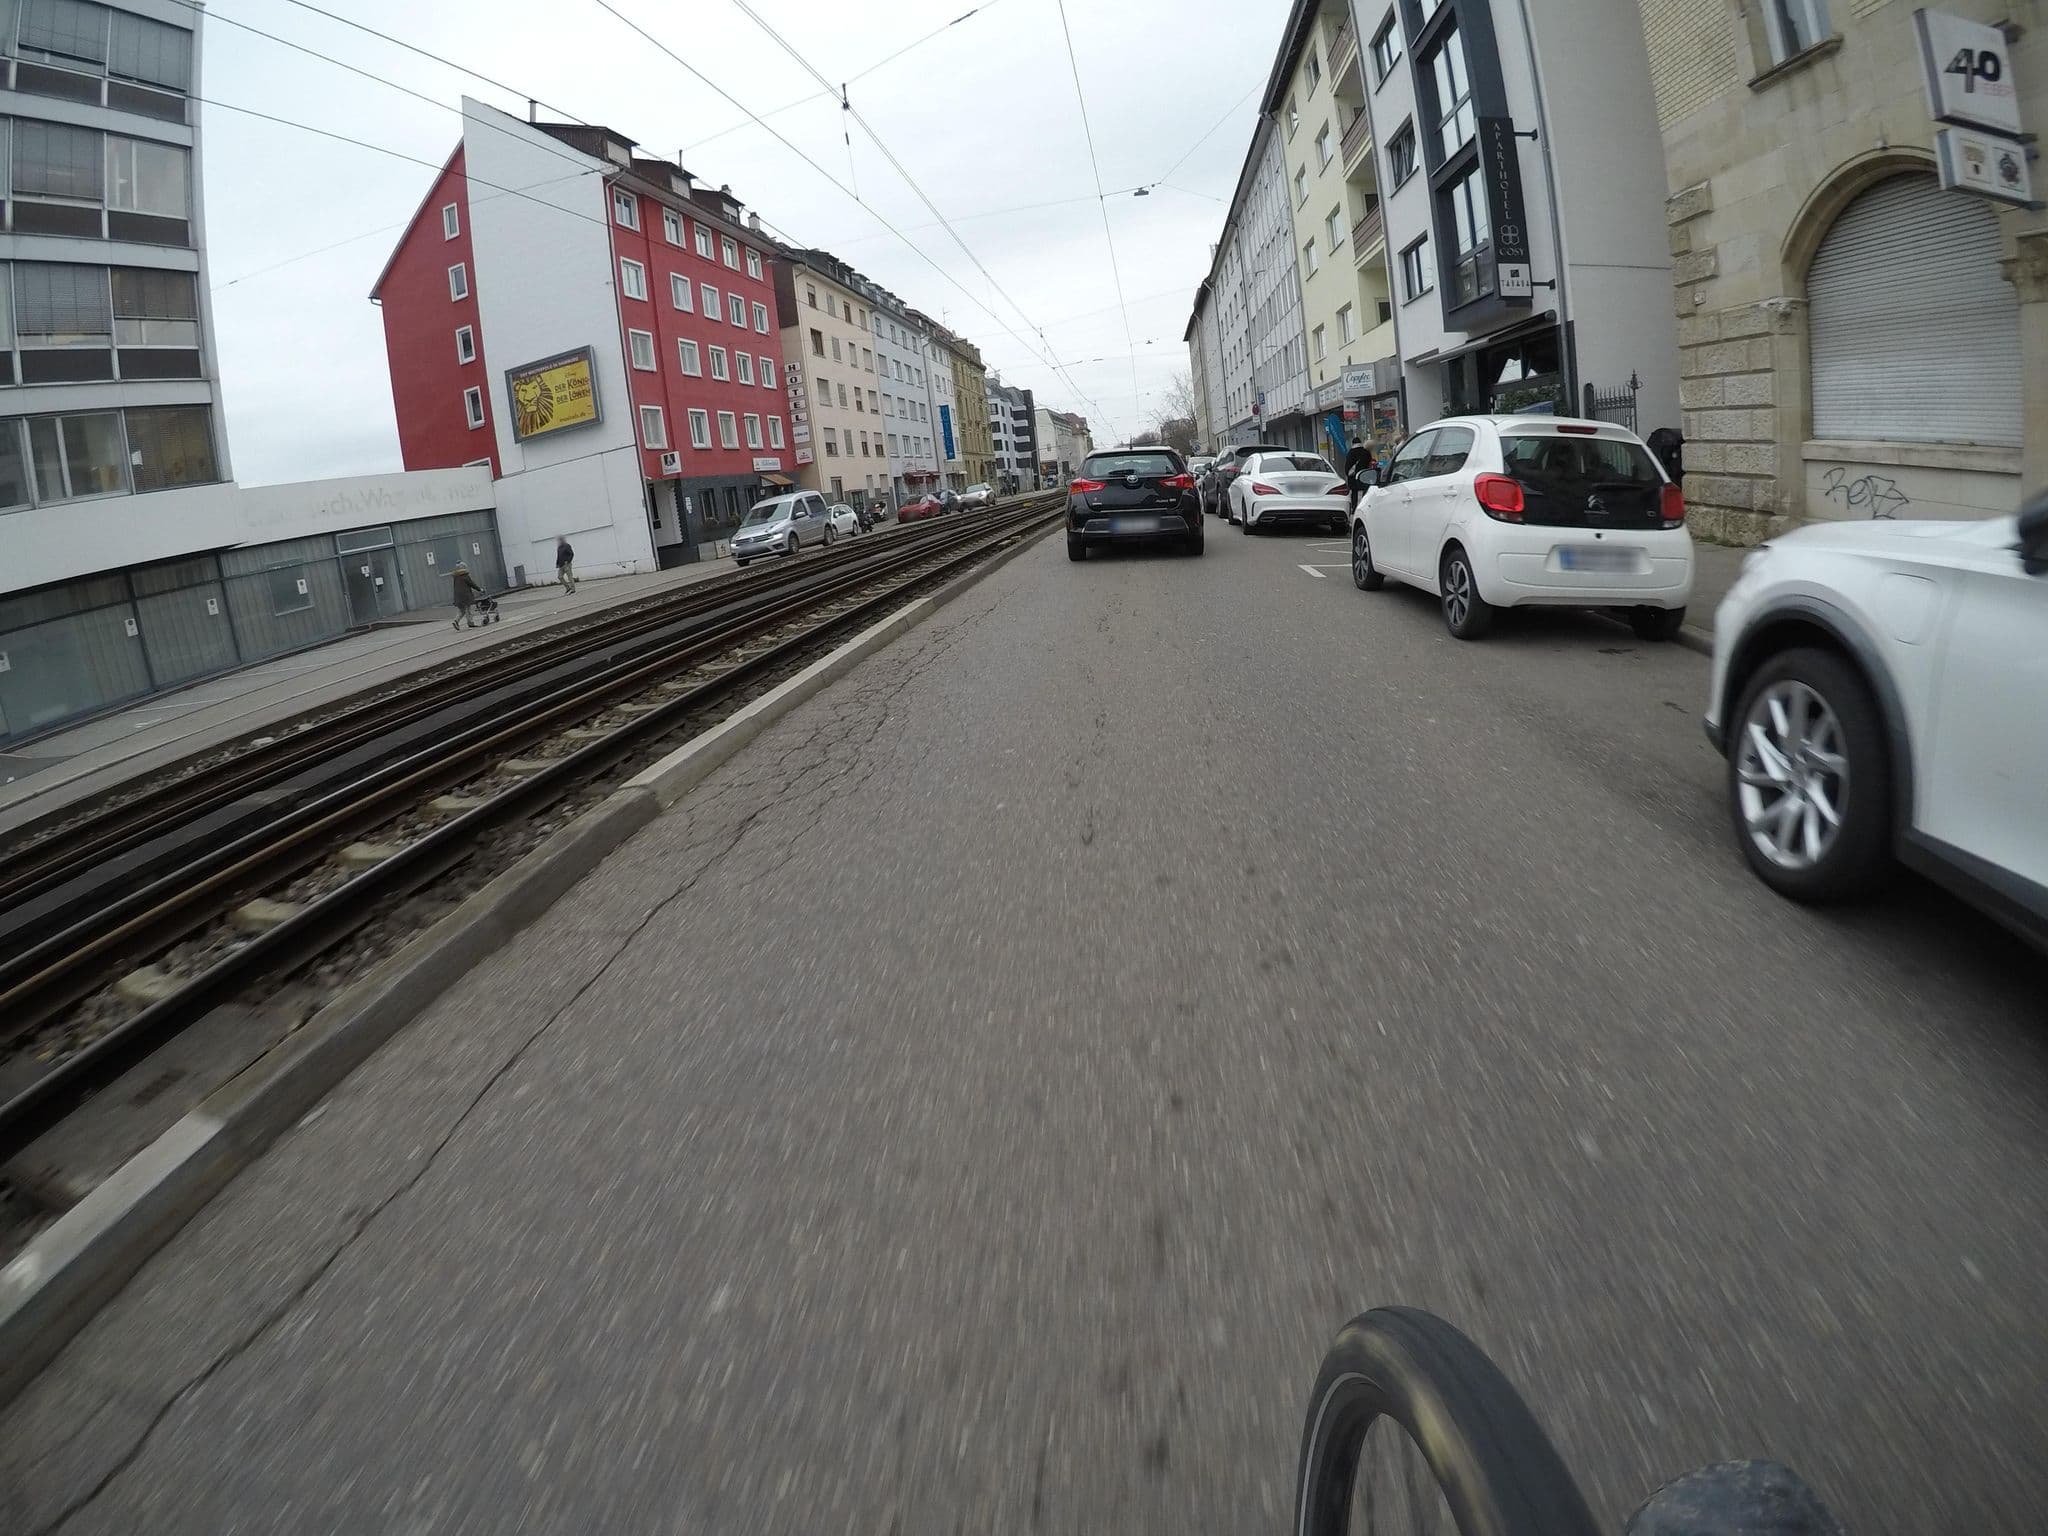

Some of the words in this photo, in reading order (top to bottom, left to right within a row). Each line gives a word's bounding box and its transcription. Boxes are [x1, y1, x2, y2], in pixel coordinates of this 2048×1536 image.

[1493, 122, 1511, 219] APARTHOTEL
[1499, 248, 1524, 257] COSY
[788, 364, 803, 421] HOTEL
